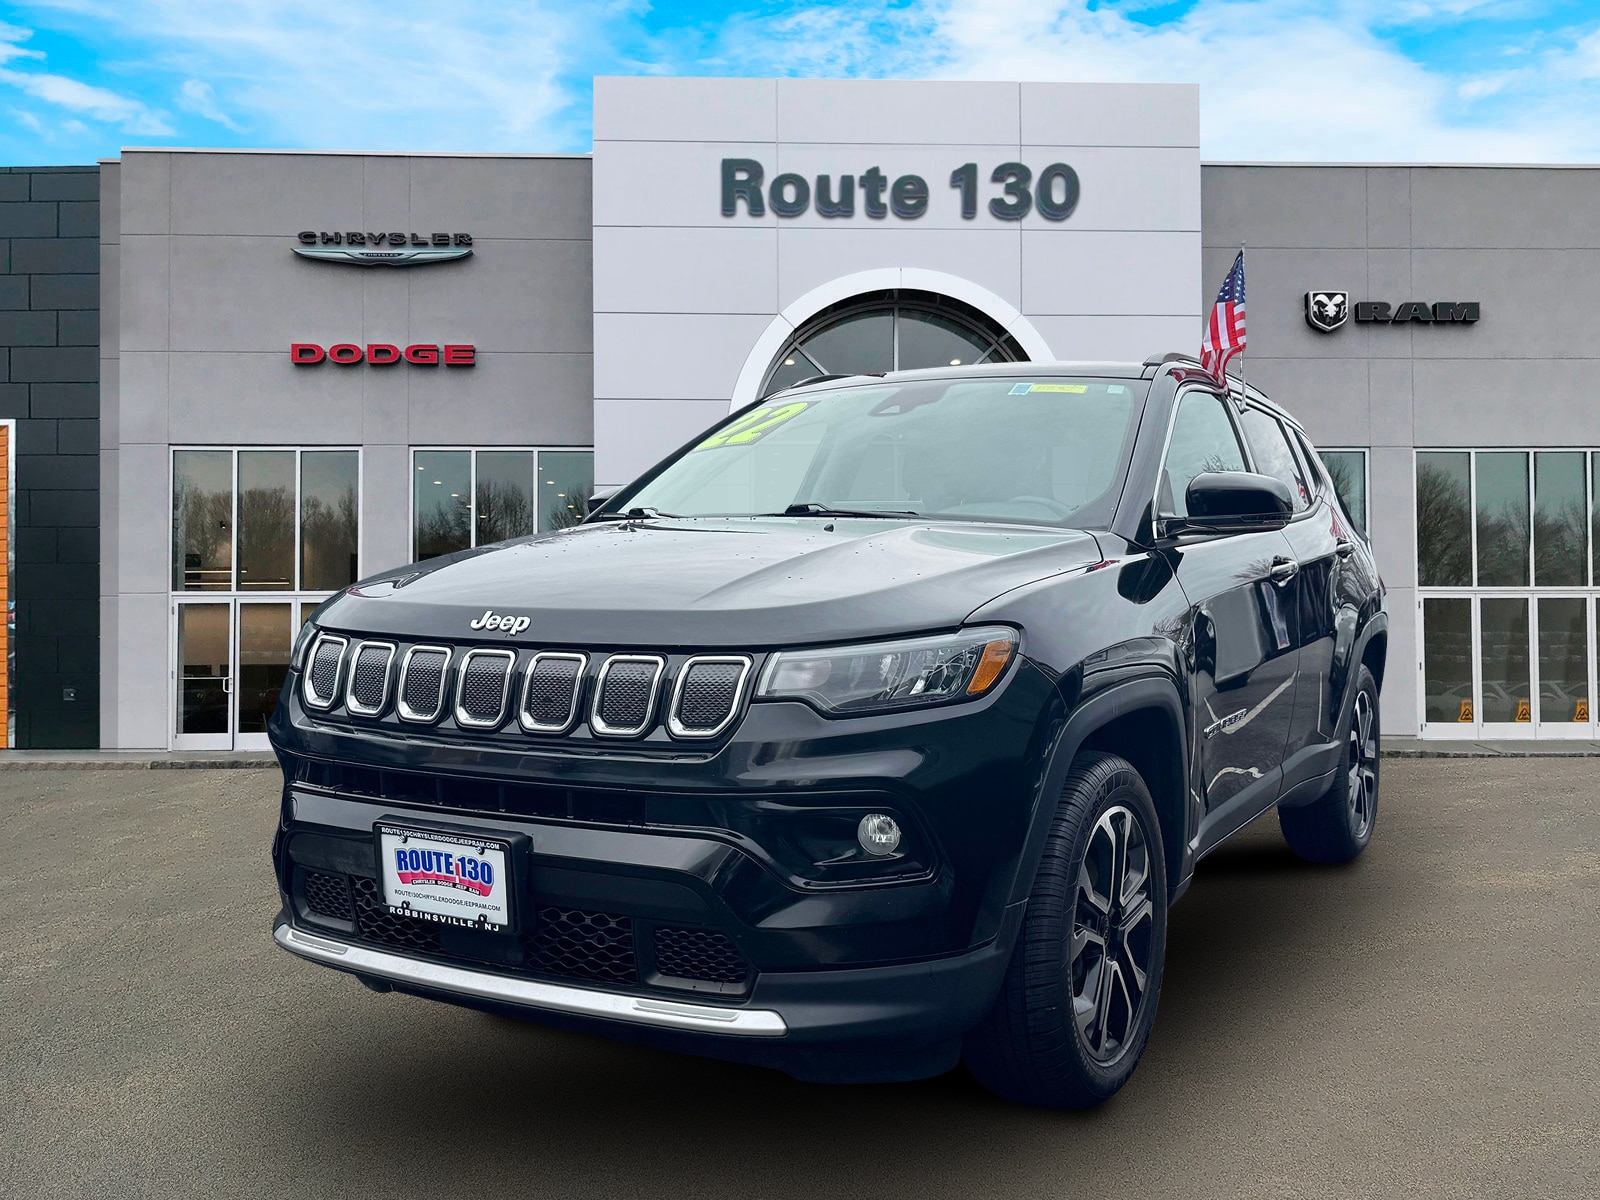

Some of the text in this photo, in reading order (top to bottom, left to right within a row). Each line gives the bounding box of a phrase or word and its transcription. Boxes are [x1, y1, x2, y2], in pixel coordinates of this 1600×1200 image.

[721, 158, 1080, 220] Route 130
[298, 231, 473, 246] CHRYSLER
[1354, 302, 1480, 325] RAM
[290, 343, 475, 367] DODGE
[470, 610, 532, 636] Jeep
[381, 827, 500, 850] ROUTE130CHRYSLERDODGEJEEPRAM.COM
[396, 849, 493, 885] ROUTE 130
[437, 880, 453, 888] DODGE
[469, 887, 480, 895] RAM
[394, 889, 501, 912] ROUTE130CHRYSLERDODGEJEEPRAM.COM
[389, 906, 500, 932] ROBBINSVILLE, NJ
